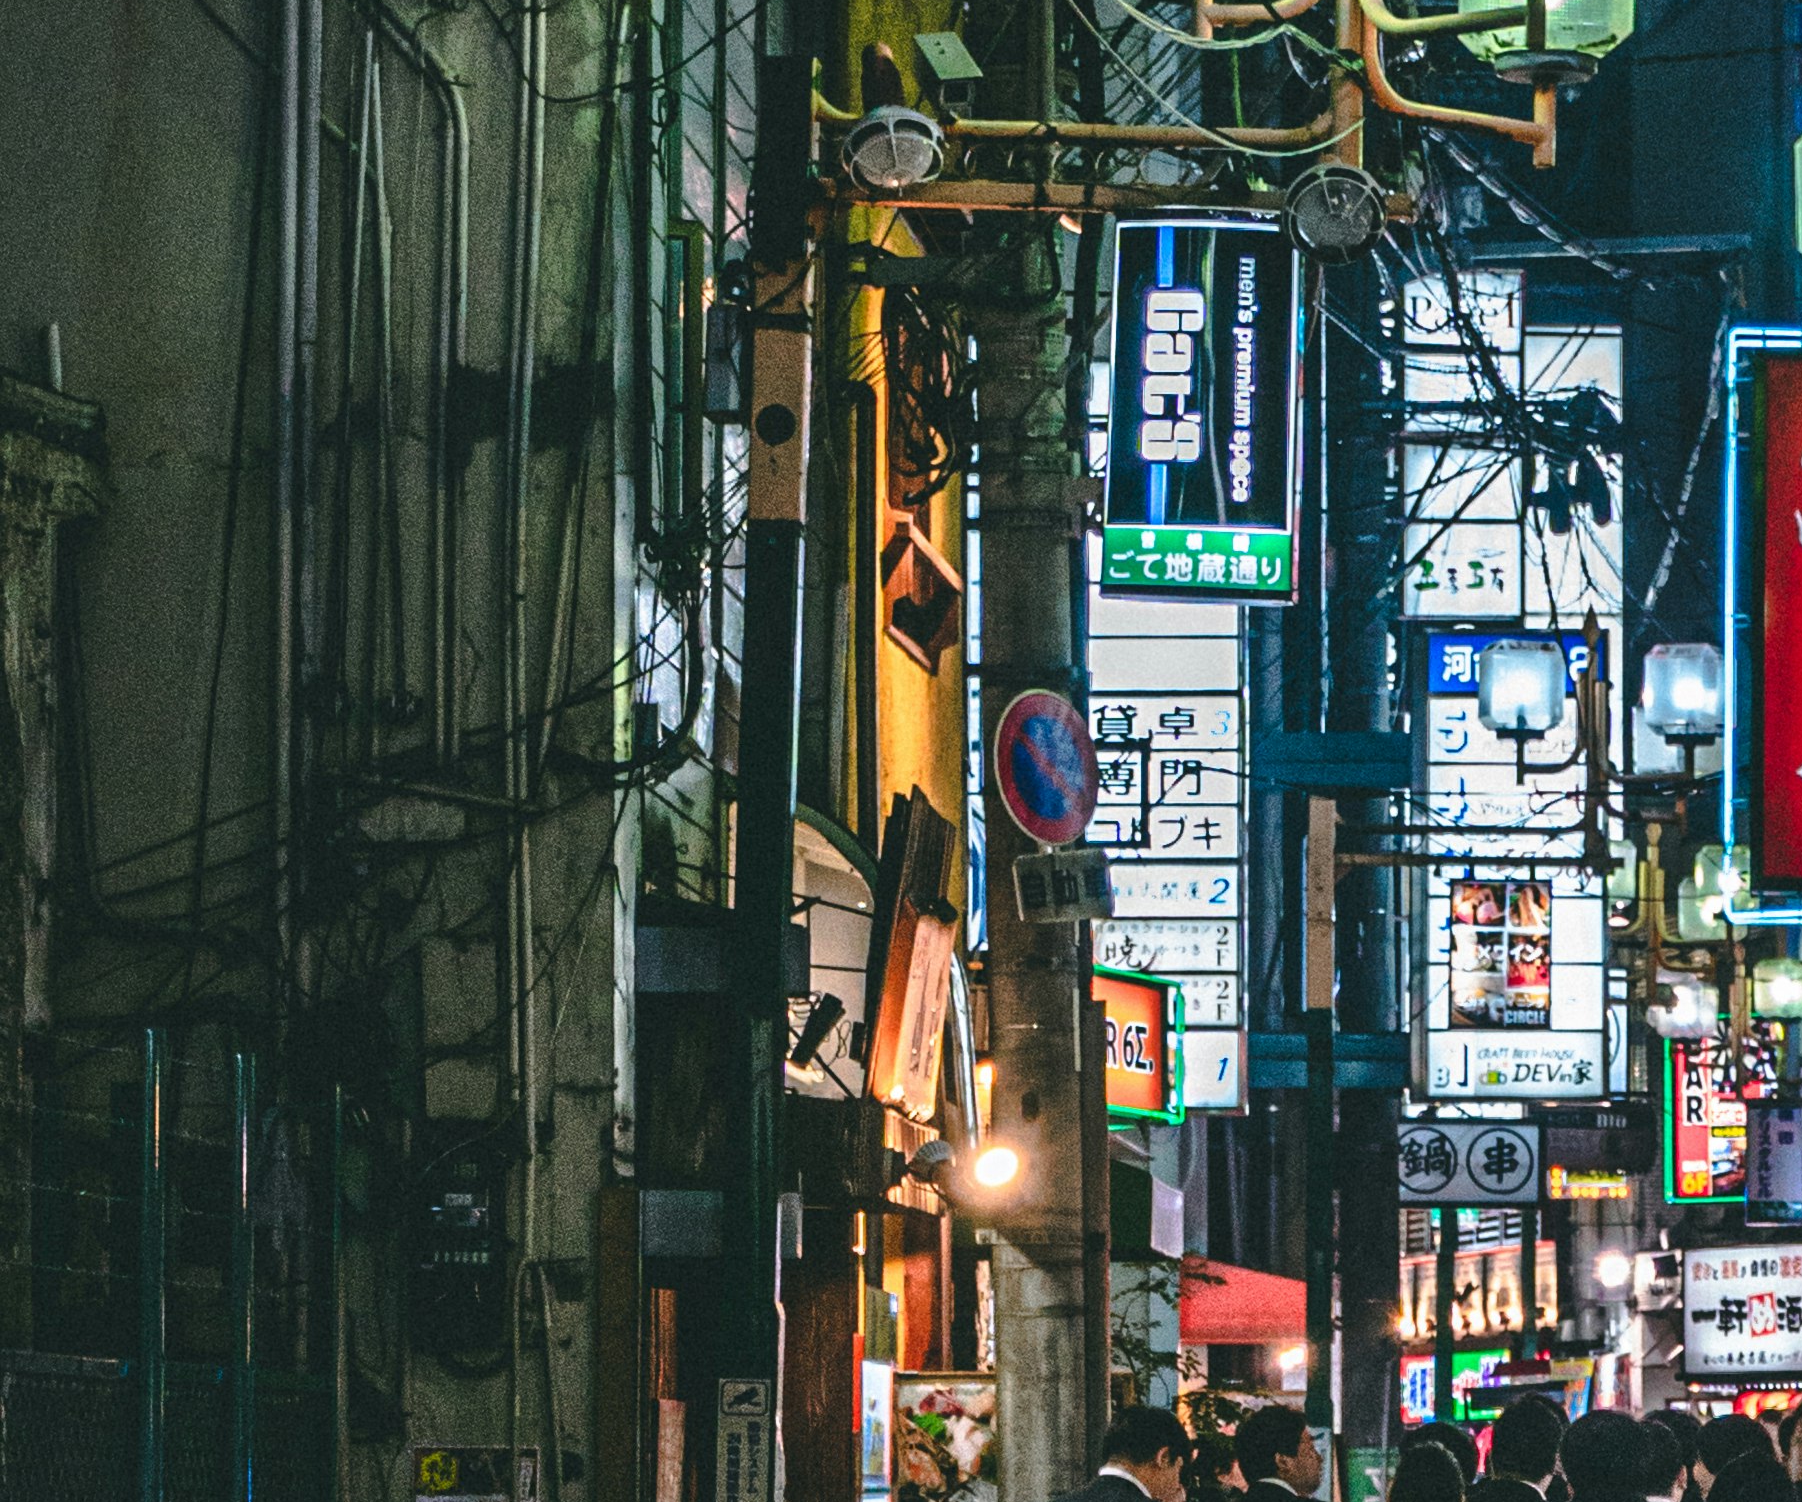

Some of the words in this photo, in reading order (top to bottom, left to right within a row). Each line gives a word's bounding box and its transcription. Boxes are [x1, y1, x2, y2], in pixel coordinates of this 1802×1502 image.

[1237, 256, 1260, 324] men's
[1232, 327, 1256, 428] premium
[1109, 549, 1282, 585] ごて地蔵通り
[1092, 704, 1200, 743] 貸卓
[1210, 709, 1232, 736] 3
[1208, 877, 1231, 905] 2
[1504, 1010, 1546, 1025] CIRCLE
[1216, 1056, 1229, 1082] 1
[1401, 1135, 1452, 1180] 鍋
[1482, 1136, 1520, 1184] 串
[1681, 1171, 1710, 1195] 6F
